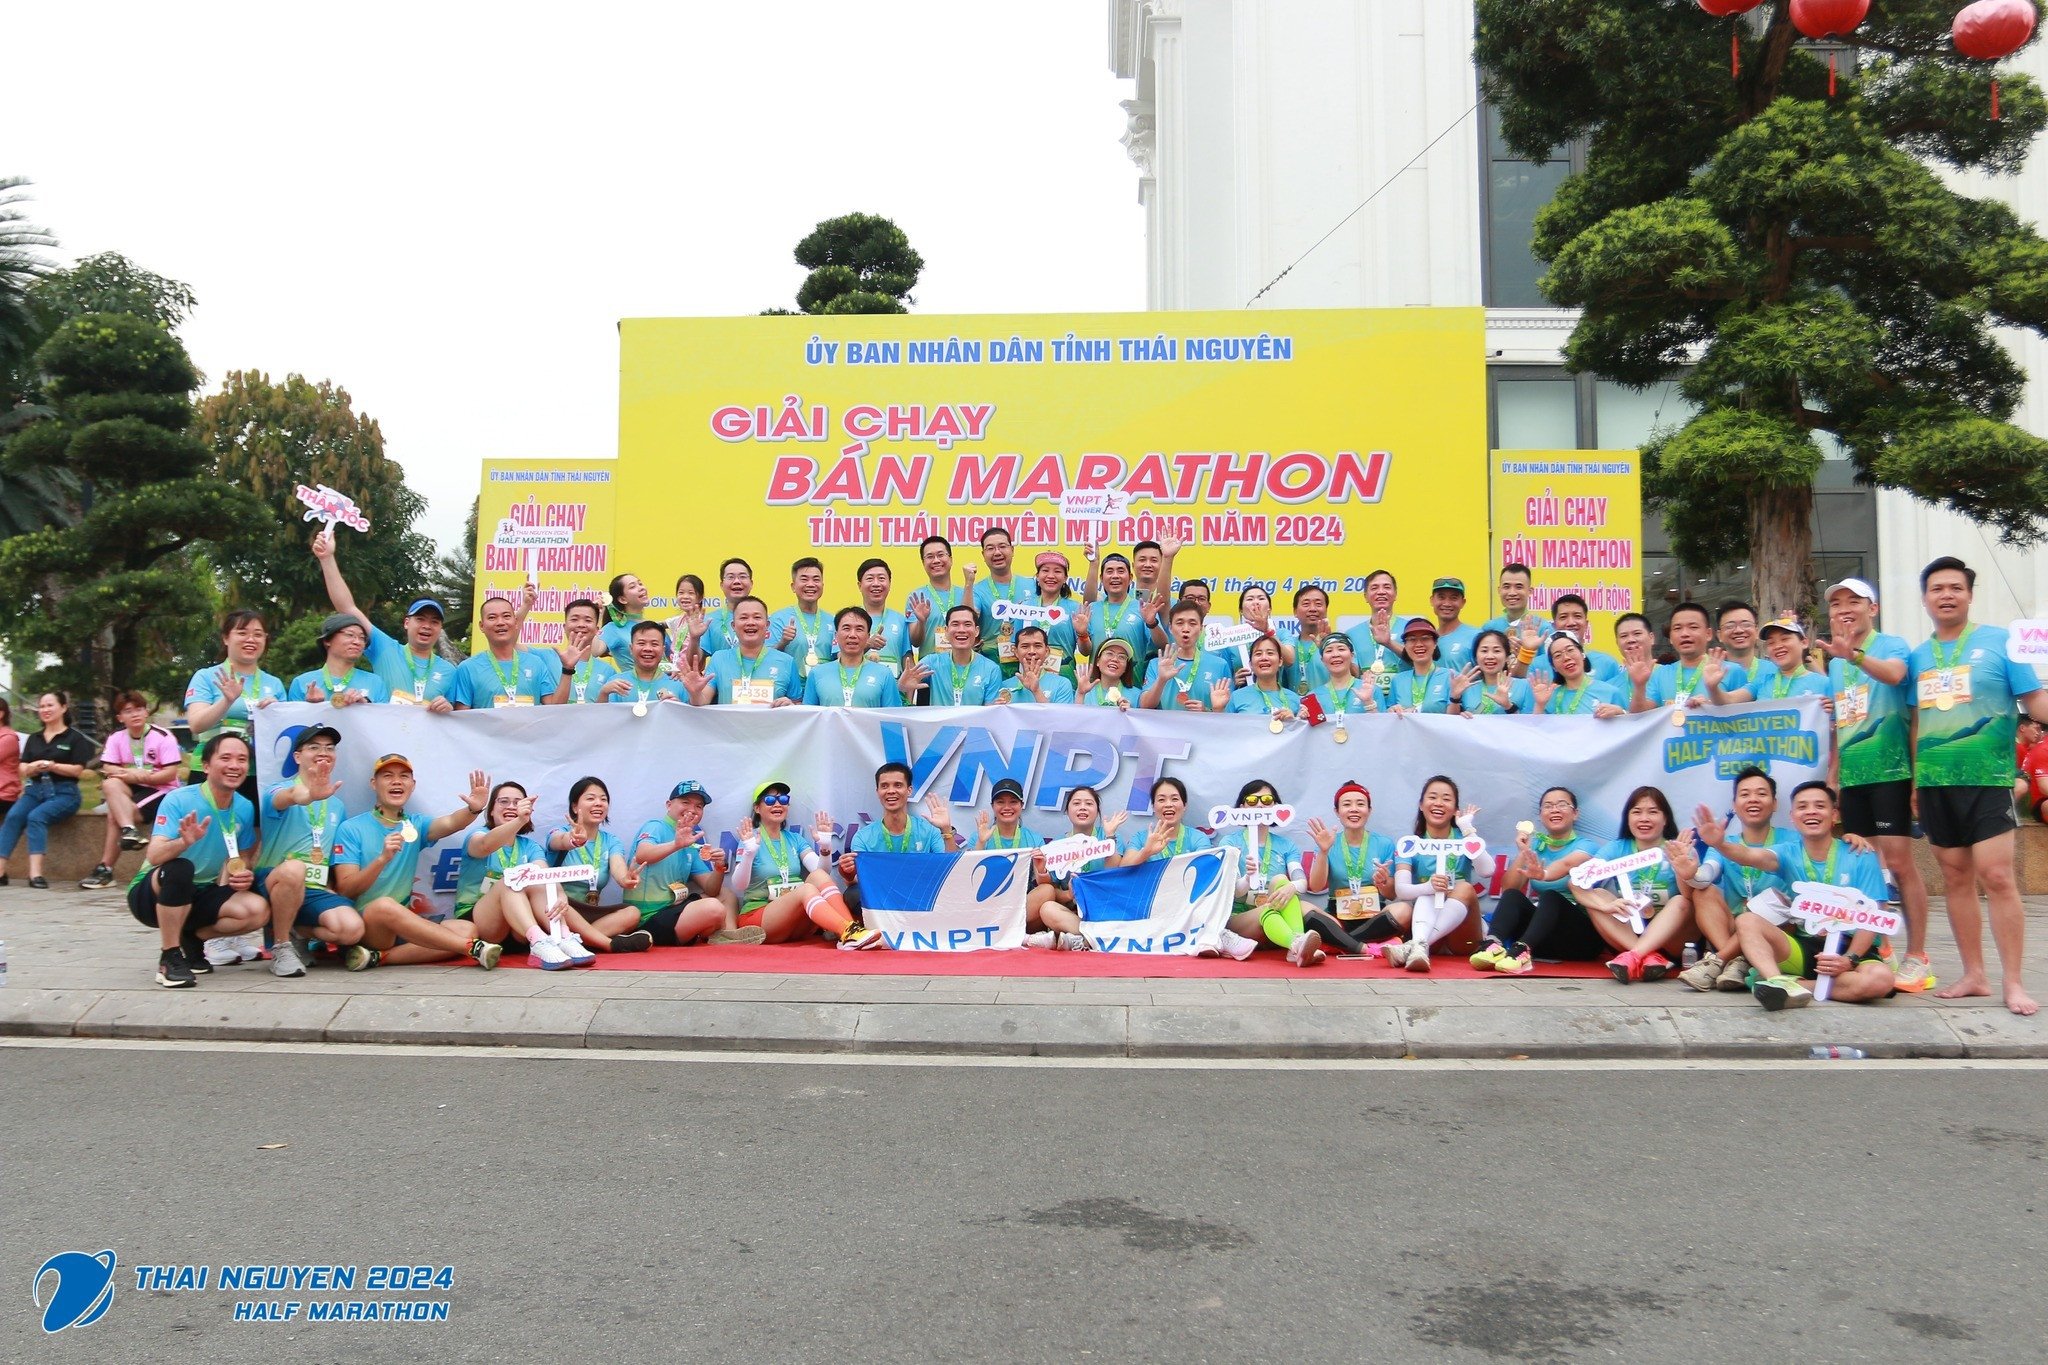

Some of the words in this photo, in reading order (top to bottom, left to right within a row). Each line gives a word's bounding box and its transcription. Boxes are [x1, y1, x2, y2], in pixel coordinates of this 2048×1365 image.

[806, 336, 838, 364] ỦY
[847, 343, 900, 364] BAN
[909, 337, 980, 363] NHÂN
[990, 336, 1042, 363] DÂN
[1052, 333, 1111, 362] TỈNH
[1119, 334, 1176, 361] THÁI
[1186, 334, 1292, 360] NGUYÊN
[711, 395, 827, 440] GIẢI
[843, 404, 993, 447] CHẠY
[501, 471, 514, 481] BAN
[767, 442, 931, 502] BÁN
[947, 452, 1388, 502] MARATHON
[1513, 463, 1527, 473] BAN
[1066, 496, 1100, 505] VNPT
[1526, 488, 1559, 525] GIẢI
[1564, 497, 1607, 532] CHẠY
[809, 510, 870, 545] TỈNH
[879, 511, 942, 545] THÁI
[1202, 509, 1266, 543] NĂM
[1277, 516, 1342, 543] 2024
[1503, 534, 1536, 568] BÁN
[1542, 540, 1631, 568] MARATHON
[1224, 578, 1276, 594] tháng
[1283, 578, 1293, 591] 4
[1343, 577, 1366, 592] 20
[1606, 584, 1630, 614] RỘNG
[1010, 608, 1045, 617] VNPT
[521, 618, 540, 643] NĂM
[543, 623, 564, 643] 2024
[1208, 638, 1228, 647] HALF
[1924, 678, 1964, 696] 285
[1687, 715, 1797, 734] THAINGUYEN
[1668, 739, 1713, 767] HALF
[1717, 736, 1814, 761] MARATHON
[880, 721, 1190, 815] VNPT
[1231, 812, 1272, 821] VNPT
[1047, 843, 1111, 865] #RUN10KM
[1419, 843, 1463, 851] VNPT
[529, 868, 589, 880] #RUN21KM
[1596, 852, 1657, 876] #RUN21KM
[1341, 897, 1374, 909] 279
[1798, 900, 1895, 929] #RUN10KM
[882, 926, 1000, 950] VNPT
[1095, 924, 1206, 952] VNPT
